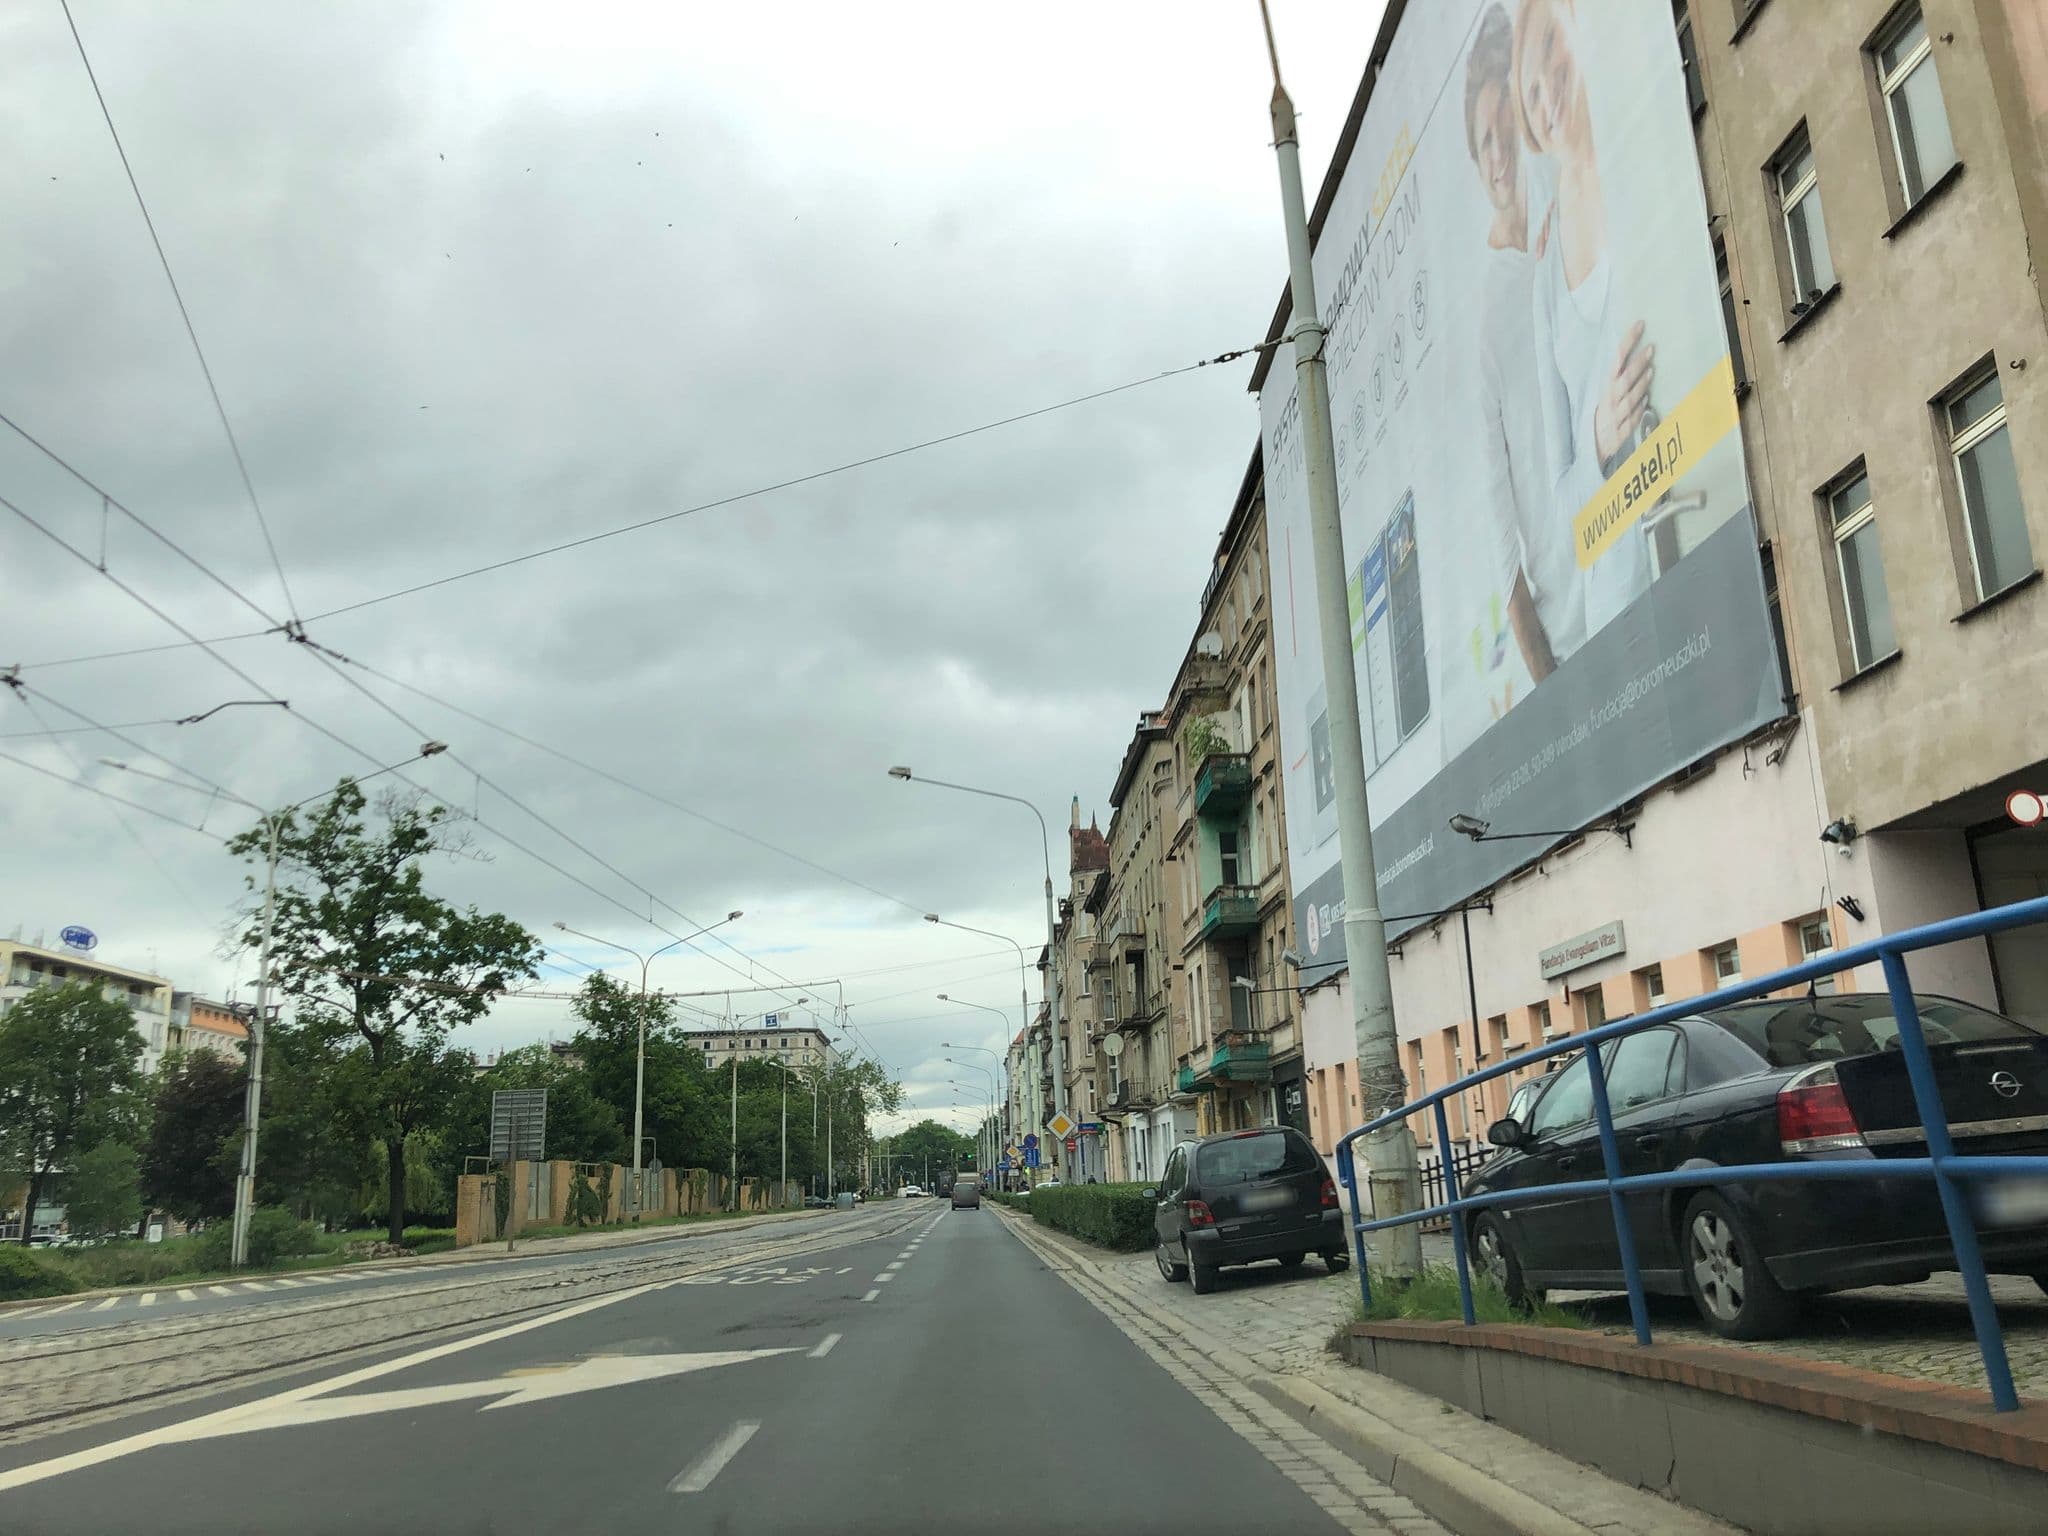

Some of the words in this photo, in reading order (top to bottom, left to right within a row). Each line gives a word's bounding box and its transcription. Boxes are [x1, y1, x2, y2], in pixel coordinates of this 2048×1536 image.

[1383, 172, 1422, 280] DOM
[1273, 383, 1300, 466] SYSTE
[1582, 421, 1684, 551] www.satel.pl
[681, 1275, 814, 1285] BUS
